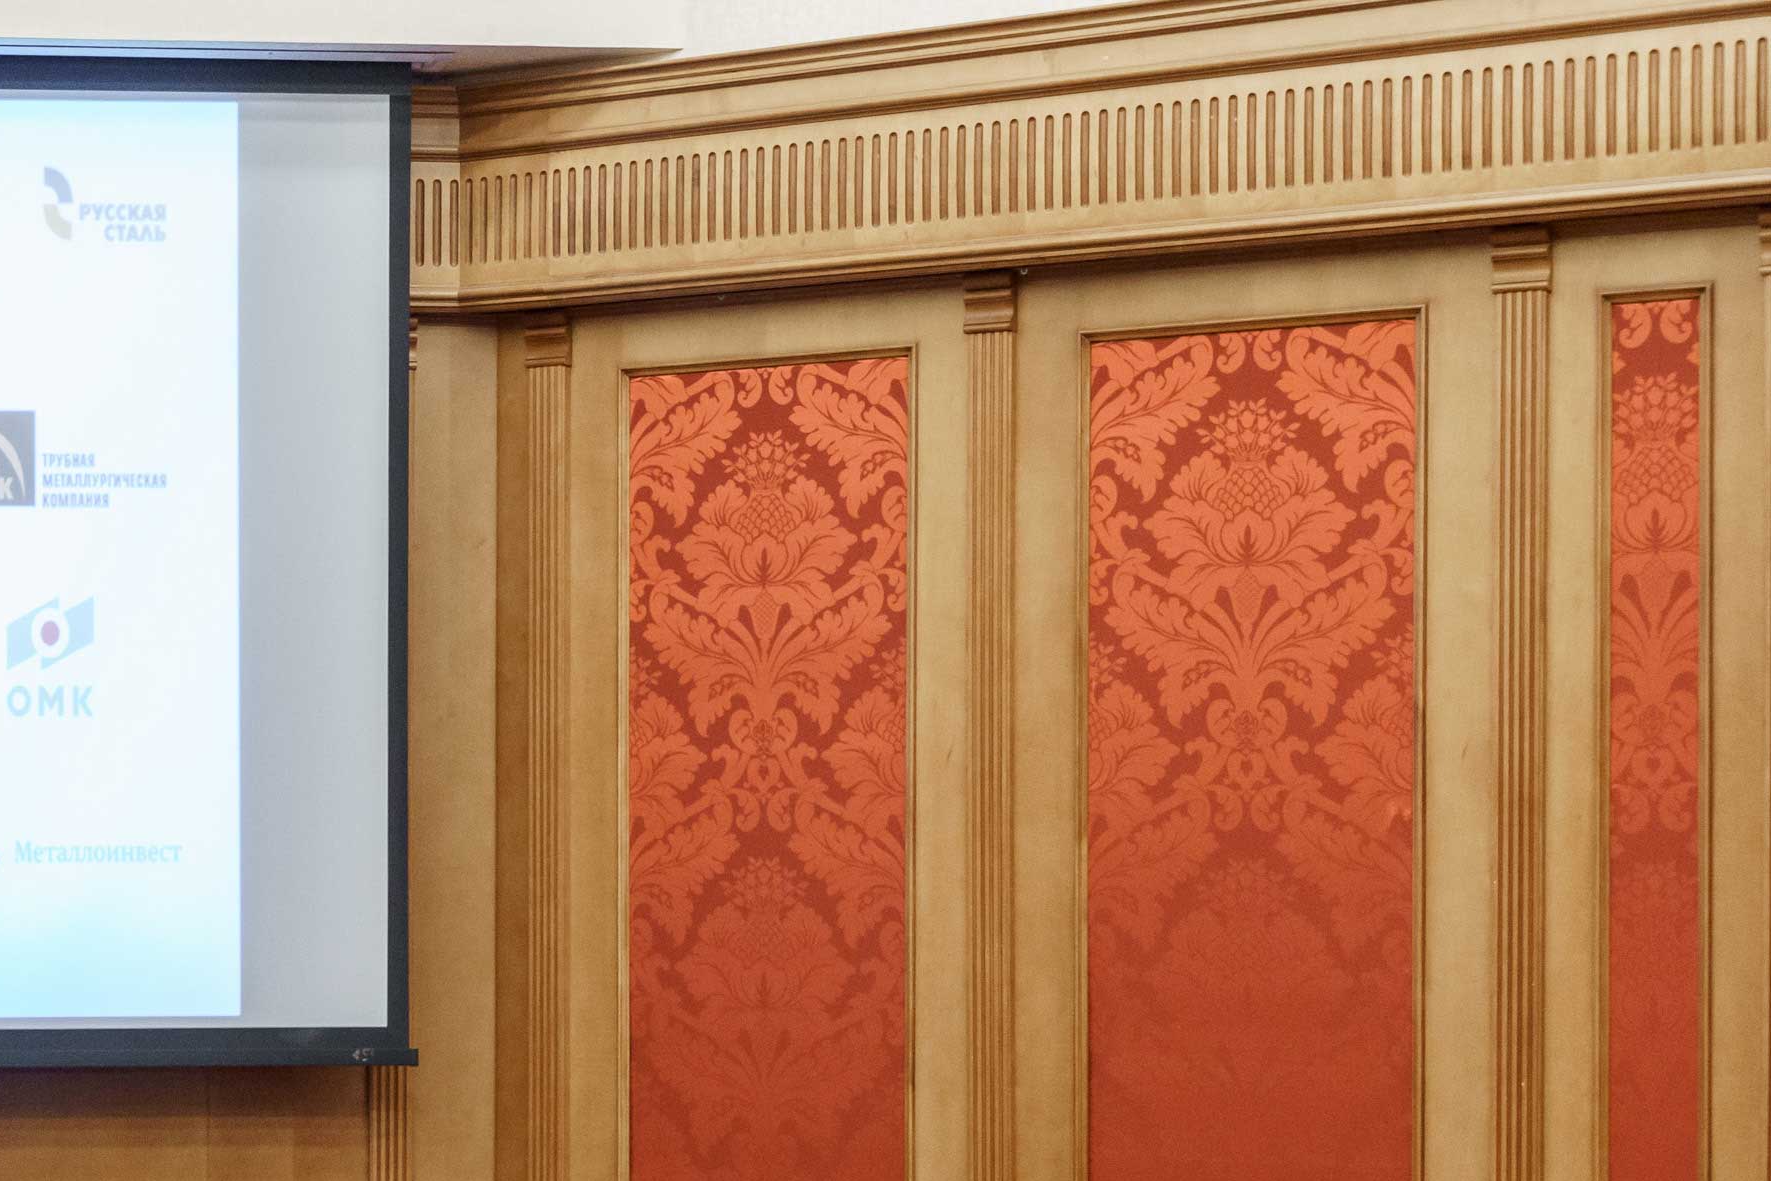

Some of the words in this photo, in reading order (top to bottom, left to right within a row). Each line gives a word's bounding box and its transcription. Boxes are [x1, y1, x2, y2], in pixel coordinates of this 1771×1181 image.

[79, 203, 167, 221] РУССКАЯ
[104, 224, 167, 242] СТАЛЬ
[42, 453, 95, 468] ТРУБНАЯ
[42, 473, 168, 489] МЕТАЛЛУРГИЧЕСКАЯ
[42, 493, 110, 508] КОМПАНИЯ
[6, 685, 94, 718] ОМК
[14, 840, 182, 864] Металлоинвест
